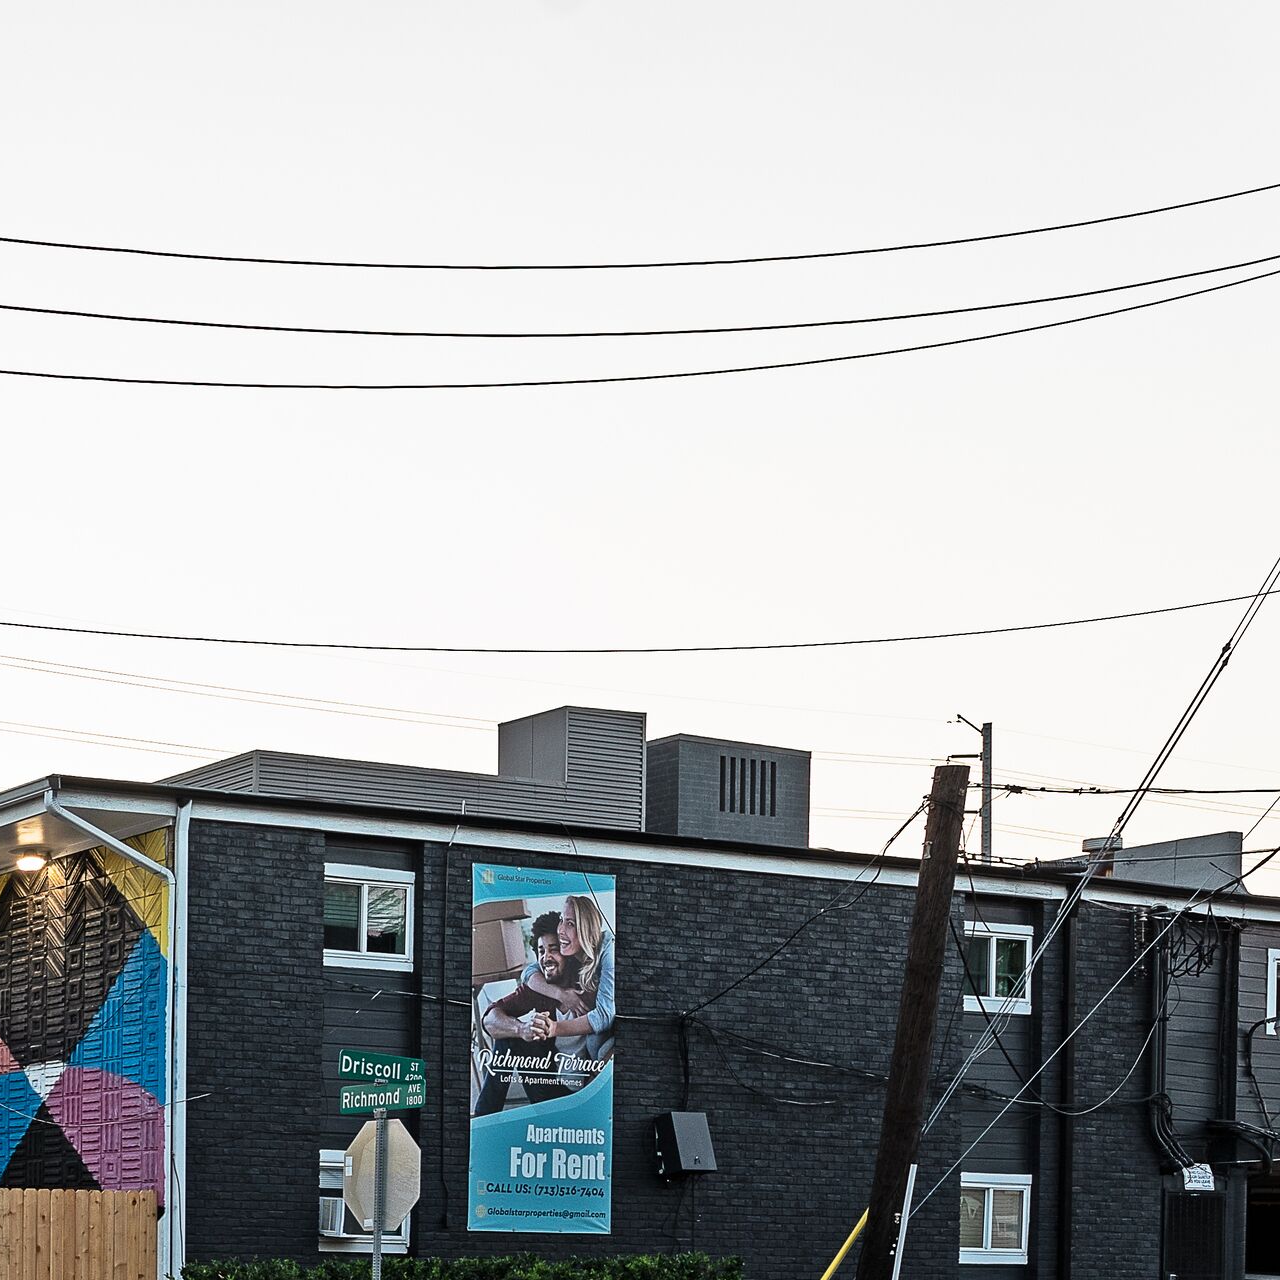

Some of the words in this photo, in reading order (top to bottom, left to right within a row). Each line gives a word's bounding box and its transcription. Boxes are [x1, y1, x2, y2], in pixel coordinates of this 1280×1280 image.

[497, 873, 514, 882] Global
[515, 875, 526, 883] Star
[526, 877, 552, 885] Properties
[341, 1055, 401, 1080] Driscoll
[410, 1062, 420, 1072] ST
[477, 1048, 552, 1077] Richmond
[553, 1052, 605, 1075] Terrace
[500, 1074, 517, 1083] Lofts
[524, 1076, 560, 1086] Apartment
[560, 1078, 582, 1087] homes
[342, 1088, 401, 1109] Richmond
[407, 1083, 422, 1094] AVE
[406, 1095, 423, 1106] 1800
[526, 1124, 605, 1145] Apartments
[510, 1146, 547, 1178] For
[552, 1148, 606, 1180] Rent
[486, 1182, 512, 1193] CALL
[515, 1184, 532, 1194] US:
[534, 1184, 605, 1198] (713)516-7404
[487, 1207, 606, 1219] Globalstarproperties@gmail.com
